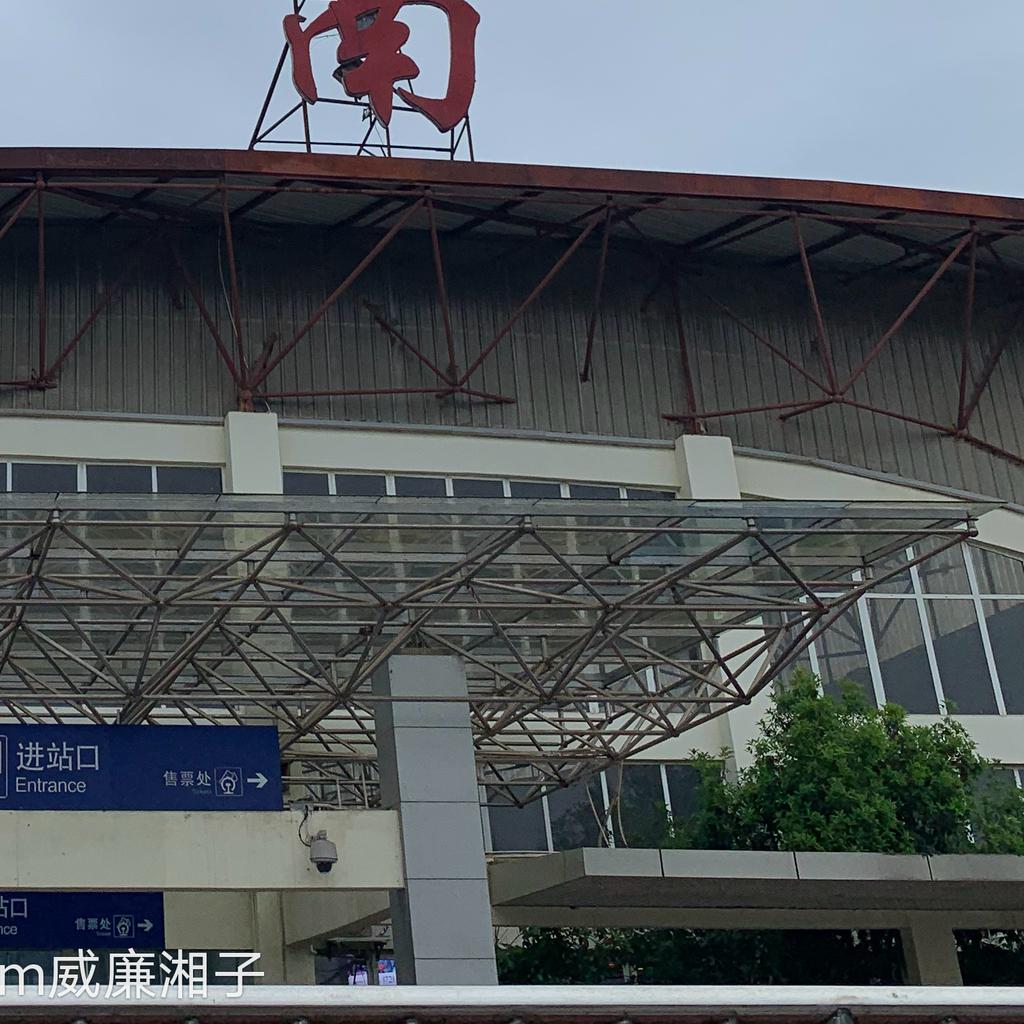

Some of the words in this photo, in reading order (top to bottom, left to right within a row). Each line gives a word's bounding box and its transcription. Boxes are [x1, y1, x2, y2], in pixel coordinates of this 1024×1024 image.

[16, 741, 100, 771] 进站口
[15, 777, 87, 793] Entrance
[163, 770, 212, 787] 售票处
